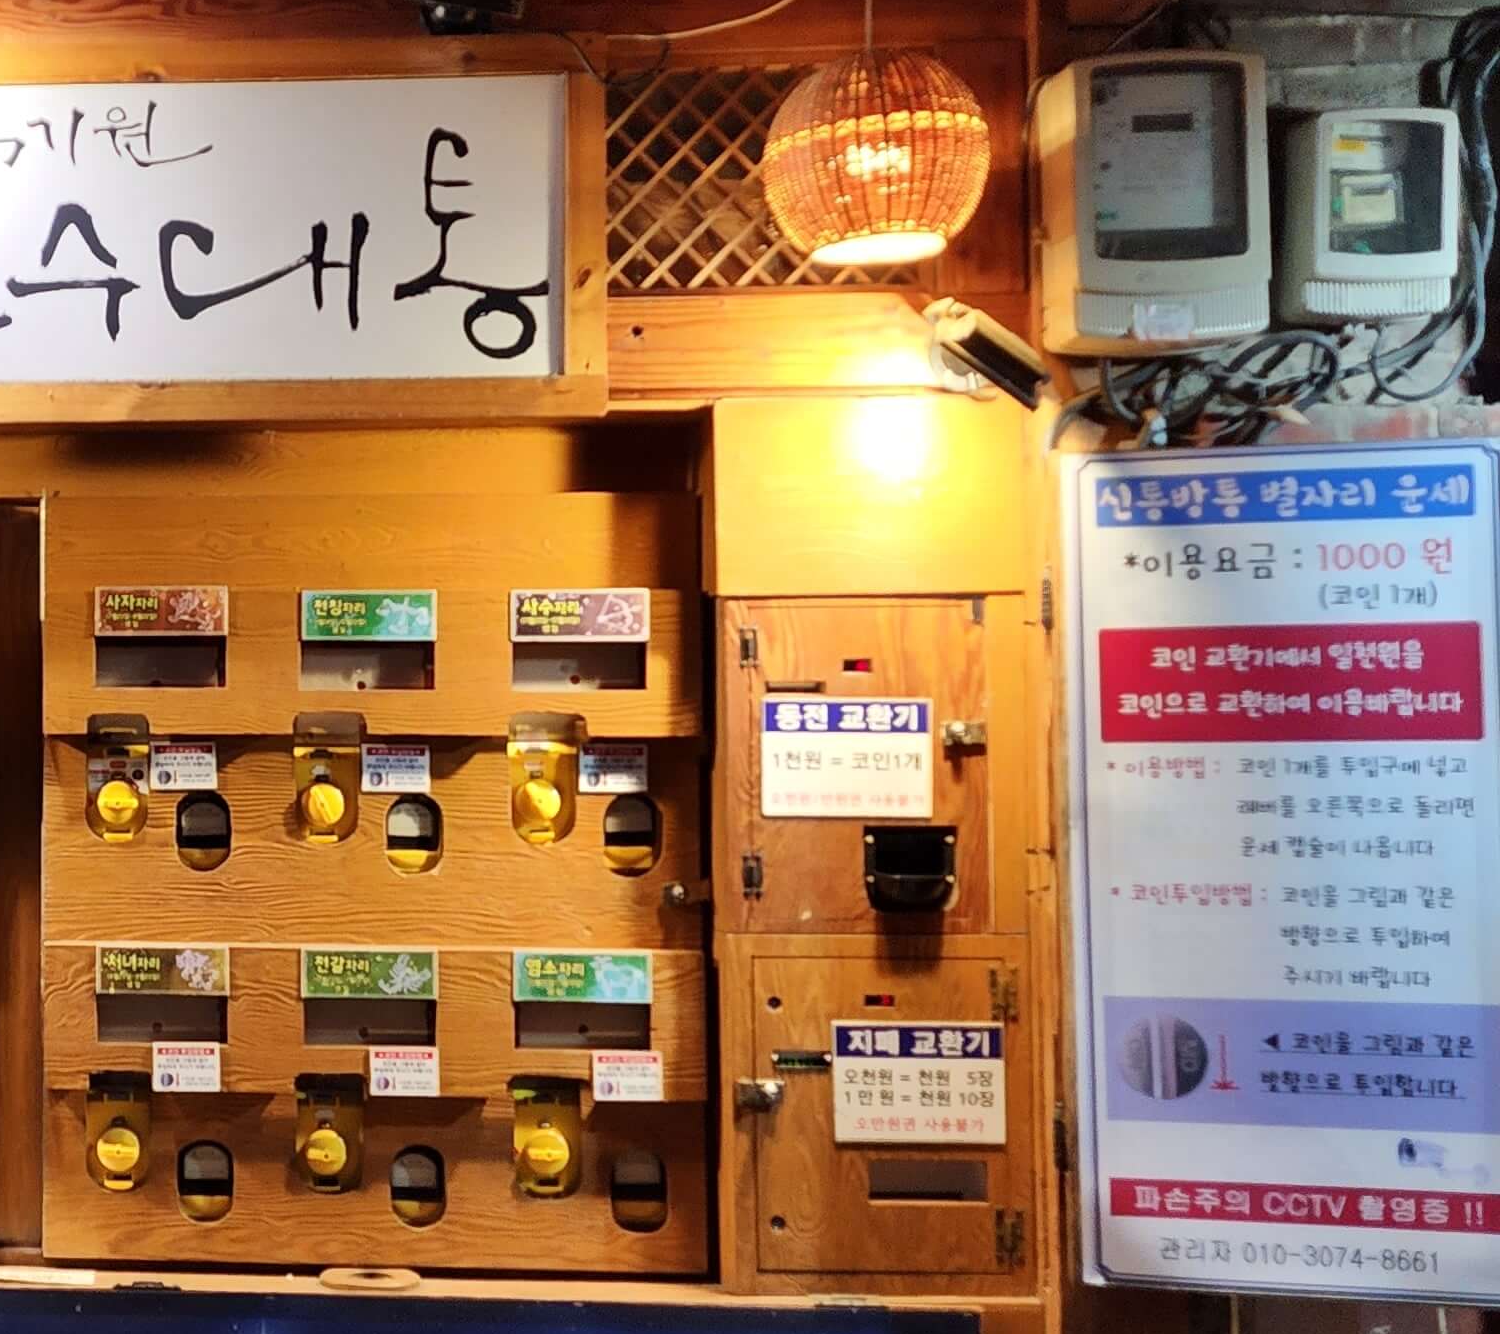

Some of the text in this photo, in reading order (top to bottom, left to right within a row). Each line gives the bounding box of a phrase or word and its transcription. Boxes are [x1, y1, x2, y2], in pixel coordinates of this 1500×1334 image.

[1100, 474, 1470, 521] 신통방통 별자리 운세
[1317, 543, 1405, 572] 1000
[1420, 536, 1453, 575] 원
[105, 595, 160, 612] 사자자리
[1319, 583, 1437, 609] (코인 1개)
[1150, 639, 1424, 672] 코인 교환기에서 일천원을
[1118, 689, 1462, 718] 코인으로 교환하여 이용바랍니다
[775, 703, 918, 731] 동전 교환기
[773, 750, 822, 770] 1천원
[1236, 756, 1277, 776] 코인
[1353, 835, 1433, 857] 나옵니다
[1131, 884, 1253, 906] 코인투입방법
[1283, 885, 1340, 907] 코인을
[1348, 886, 1407, 906] 그림과
[1416, 885, 1455, 909] 같은
[1280, 925, 1451, 948] 방향으로 투입하여
[105, 952, 161, 972] 처녀자리
[1284, 967, 1431, 989] 주시기 바랍니다
[911, 1030, 990, 1056] 교환기
[1293, 1032, 1476, 1056] 코인을 그림과 같은
[844, 1069, 893, 1086] 오천원
[919, 1069, 950, 1086] 천원
[967, 1071, 993, 1087] 5장
[1260, 1071, 1458, 1097] 방향으로 투입합니다
[919, 1090, 951, 1106] 천원
[959, 1091, 994, 1107] 10장
[1133, 1185, 1251, 1215] 파손주의
[1263, 1191, 1346, 1219] CCTV
[1358, 1195, 1450, 1223] 촬영중
[1160, 1237, 1232, 1263] 관리자
